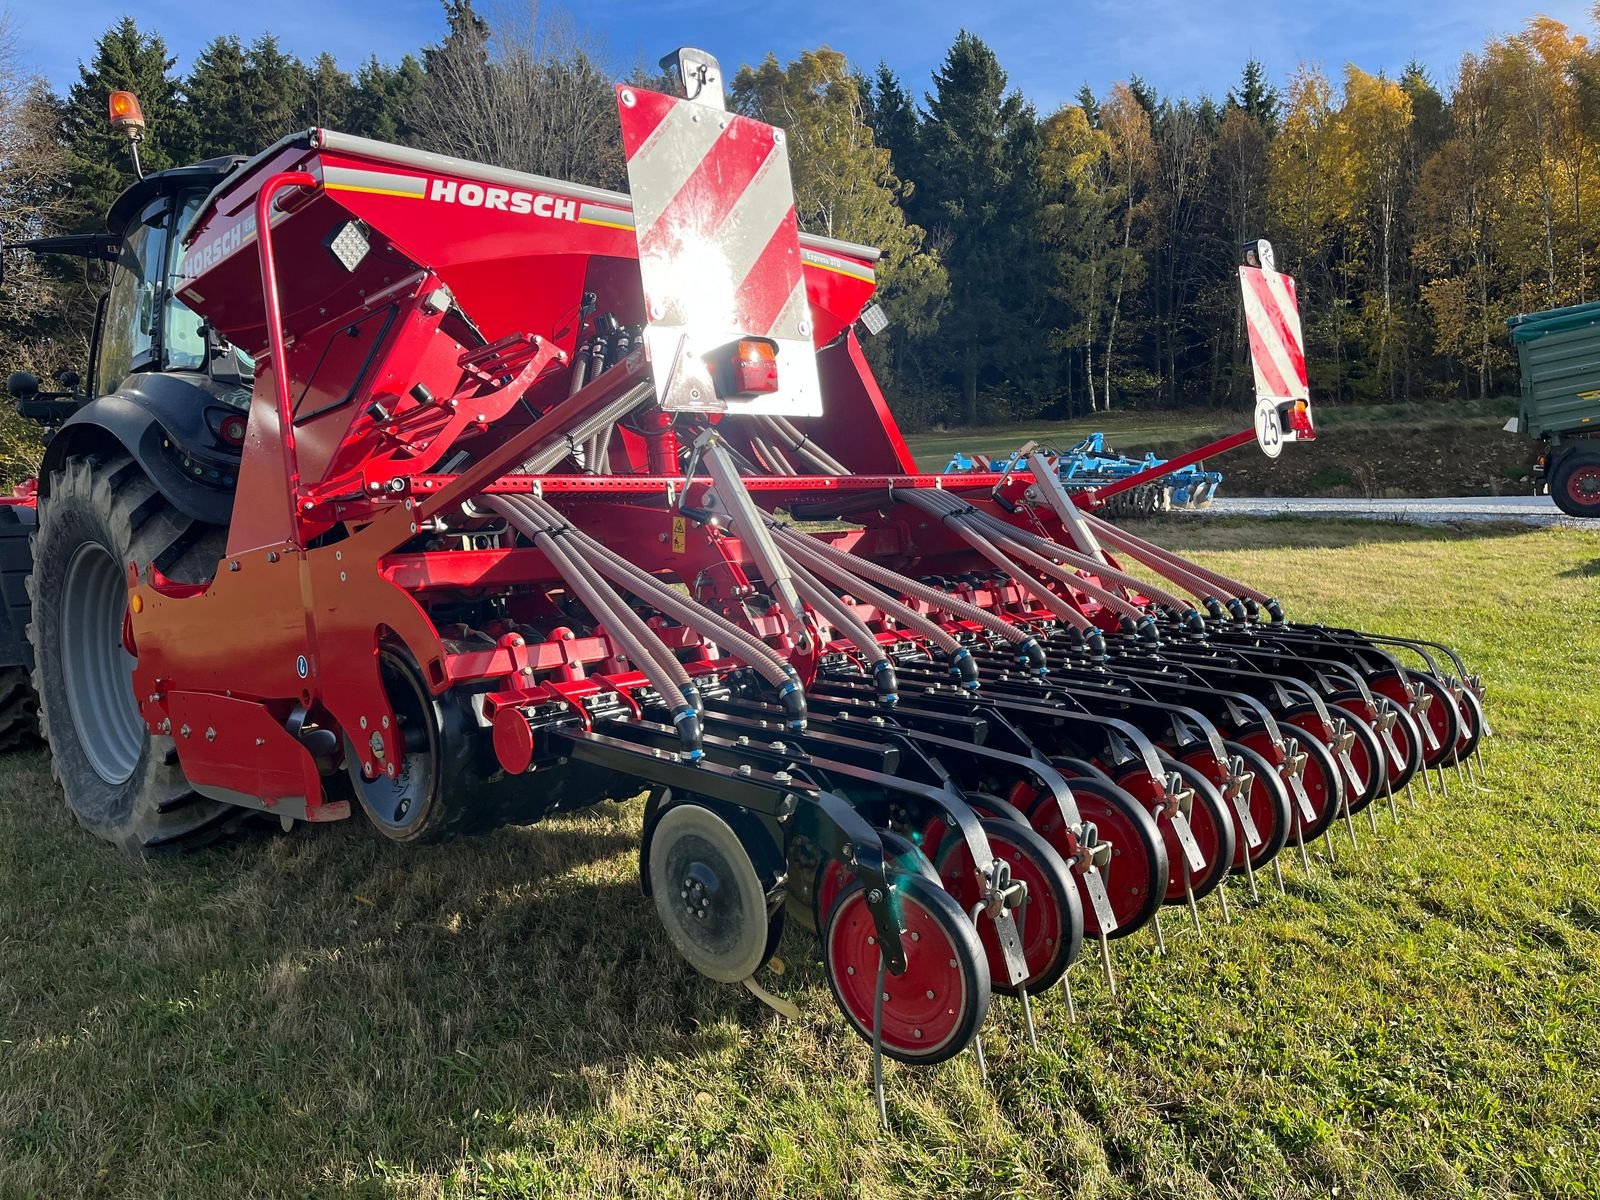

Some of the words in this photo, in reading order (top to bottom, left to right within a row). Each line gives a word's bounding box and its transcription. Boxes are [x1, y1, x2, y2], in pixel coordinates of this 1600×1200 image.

[430, 179, 576, 222] HORSCH
[184, 223, 241, 279] HORSCH
[806, 251, 830, 265] Express
[1260, 408, 1279, 446] 25
